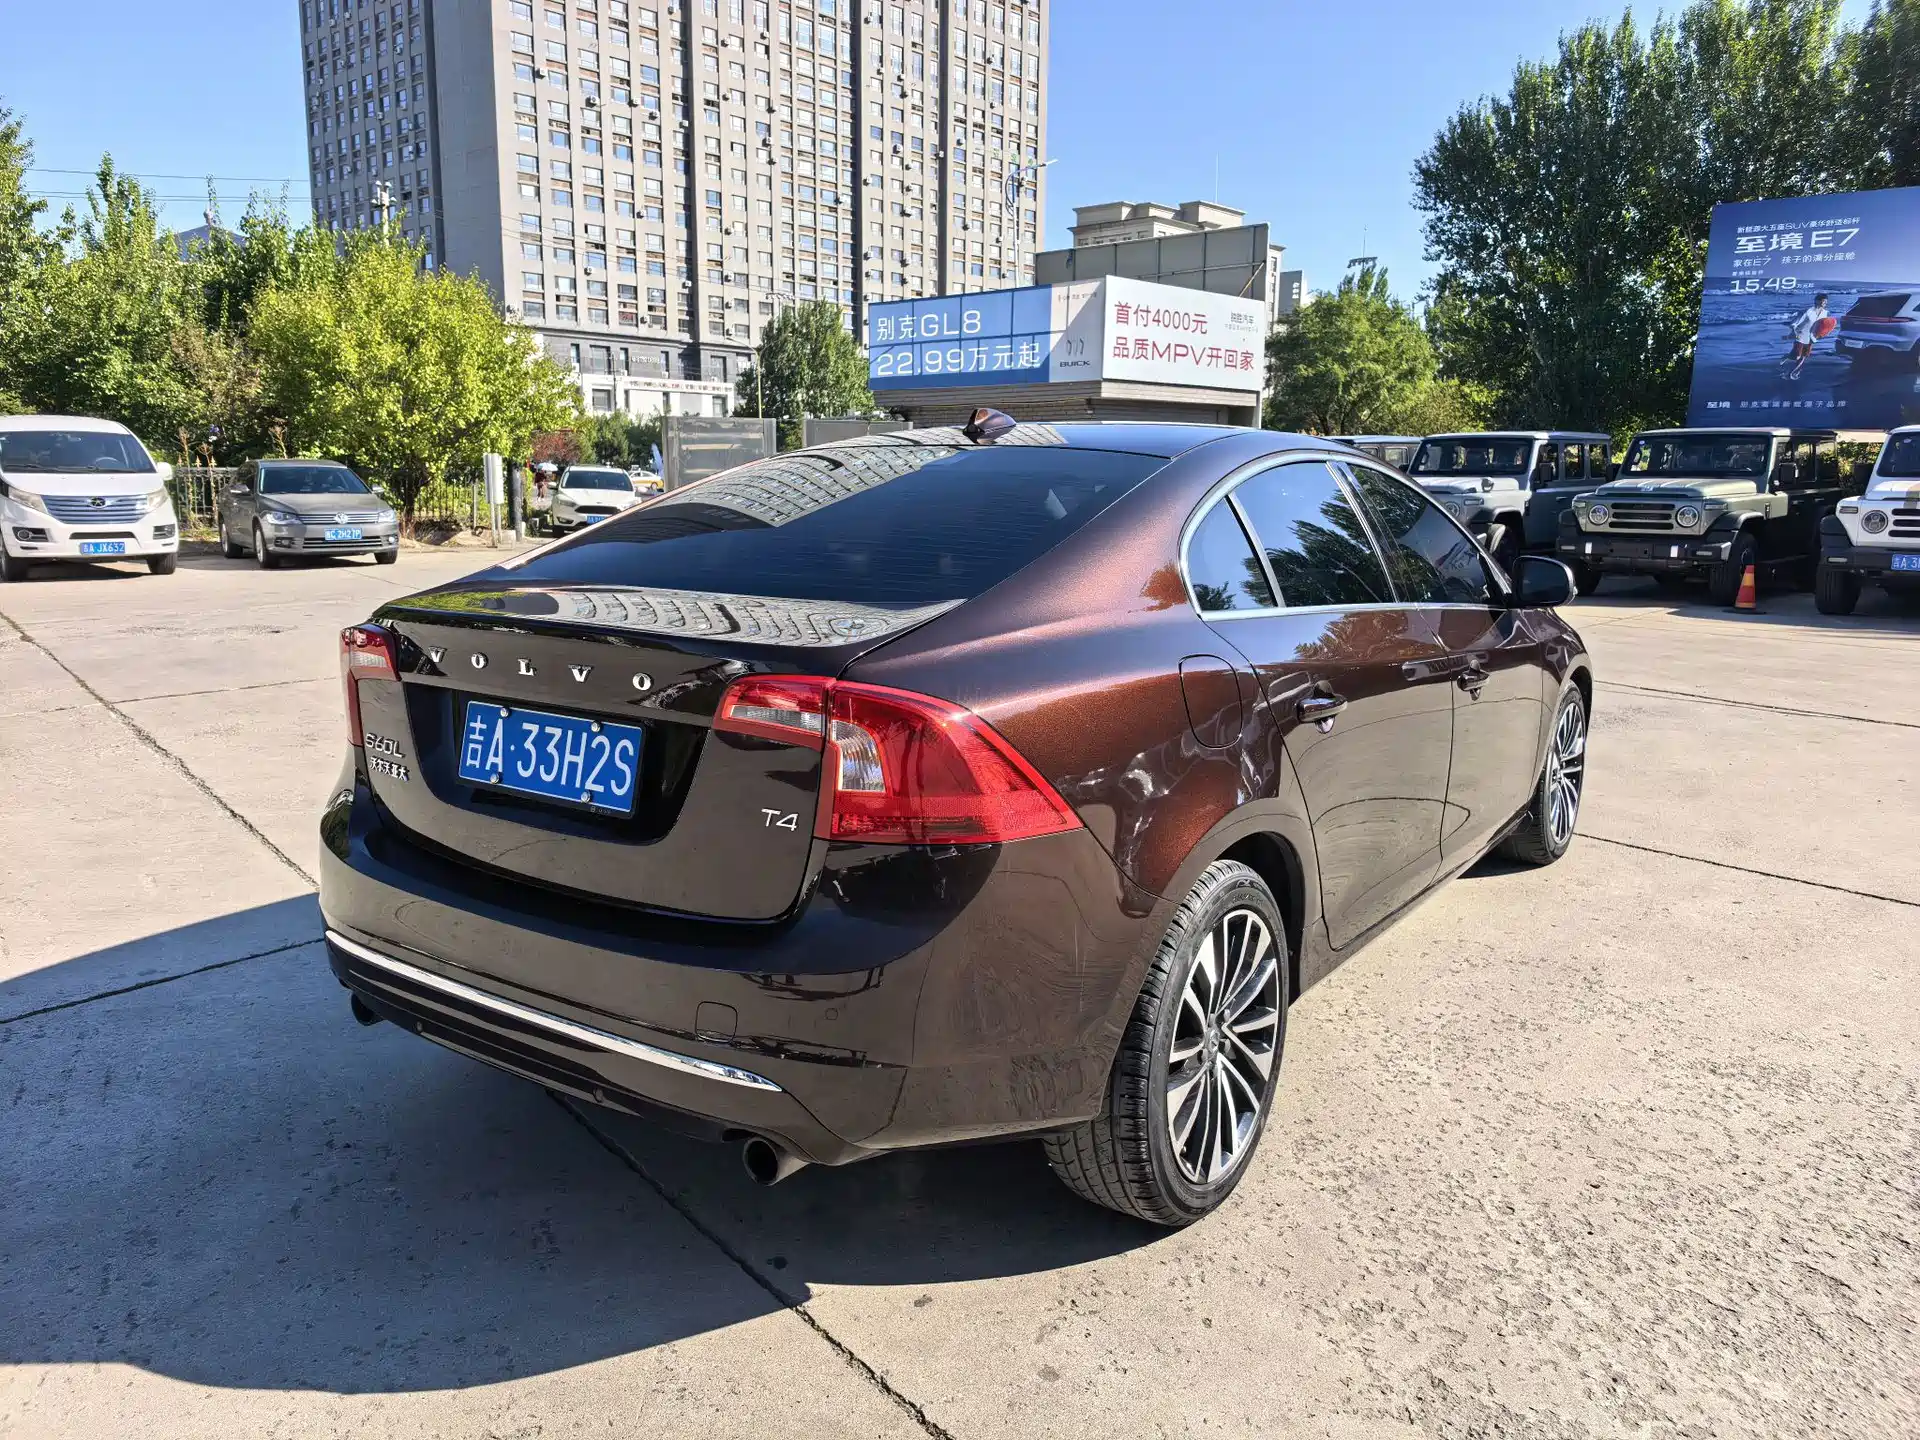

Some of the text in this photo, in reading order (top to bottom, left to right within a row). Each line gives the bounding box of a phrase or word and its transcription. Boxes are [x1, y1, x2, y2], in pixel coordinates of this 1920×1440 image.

[1734, 228, 1860, 254] 至境 E7
[876, 310, 981, 341] 别克GL8
[1114, 301, 1208, 334] 首付4000元
[877, 342, 1041, 376] 22.99万元起
[1059, 360, 1091, 368] BUICK
[1113, 336, 1255, 371] 品质MPV开回家
[427, 645, 655, 692] VOLVO
[365, 733, 404, 758] S60L
[761, 808, 799, 831] T4
